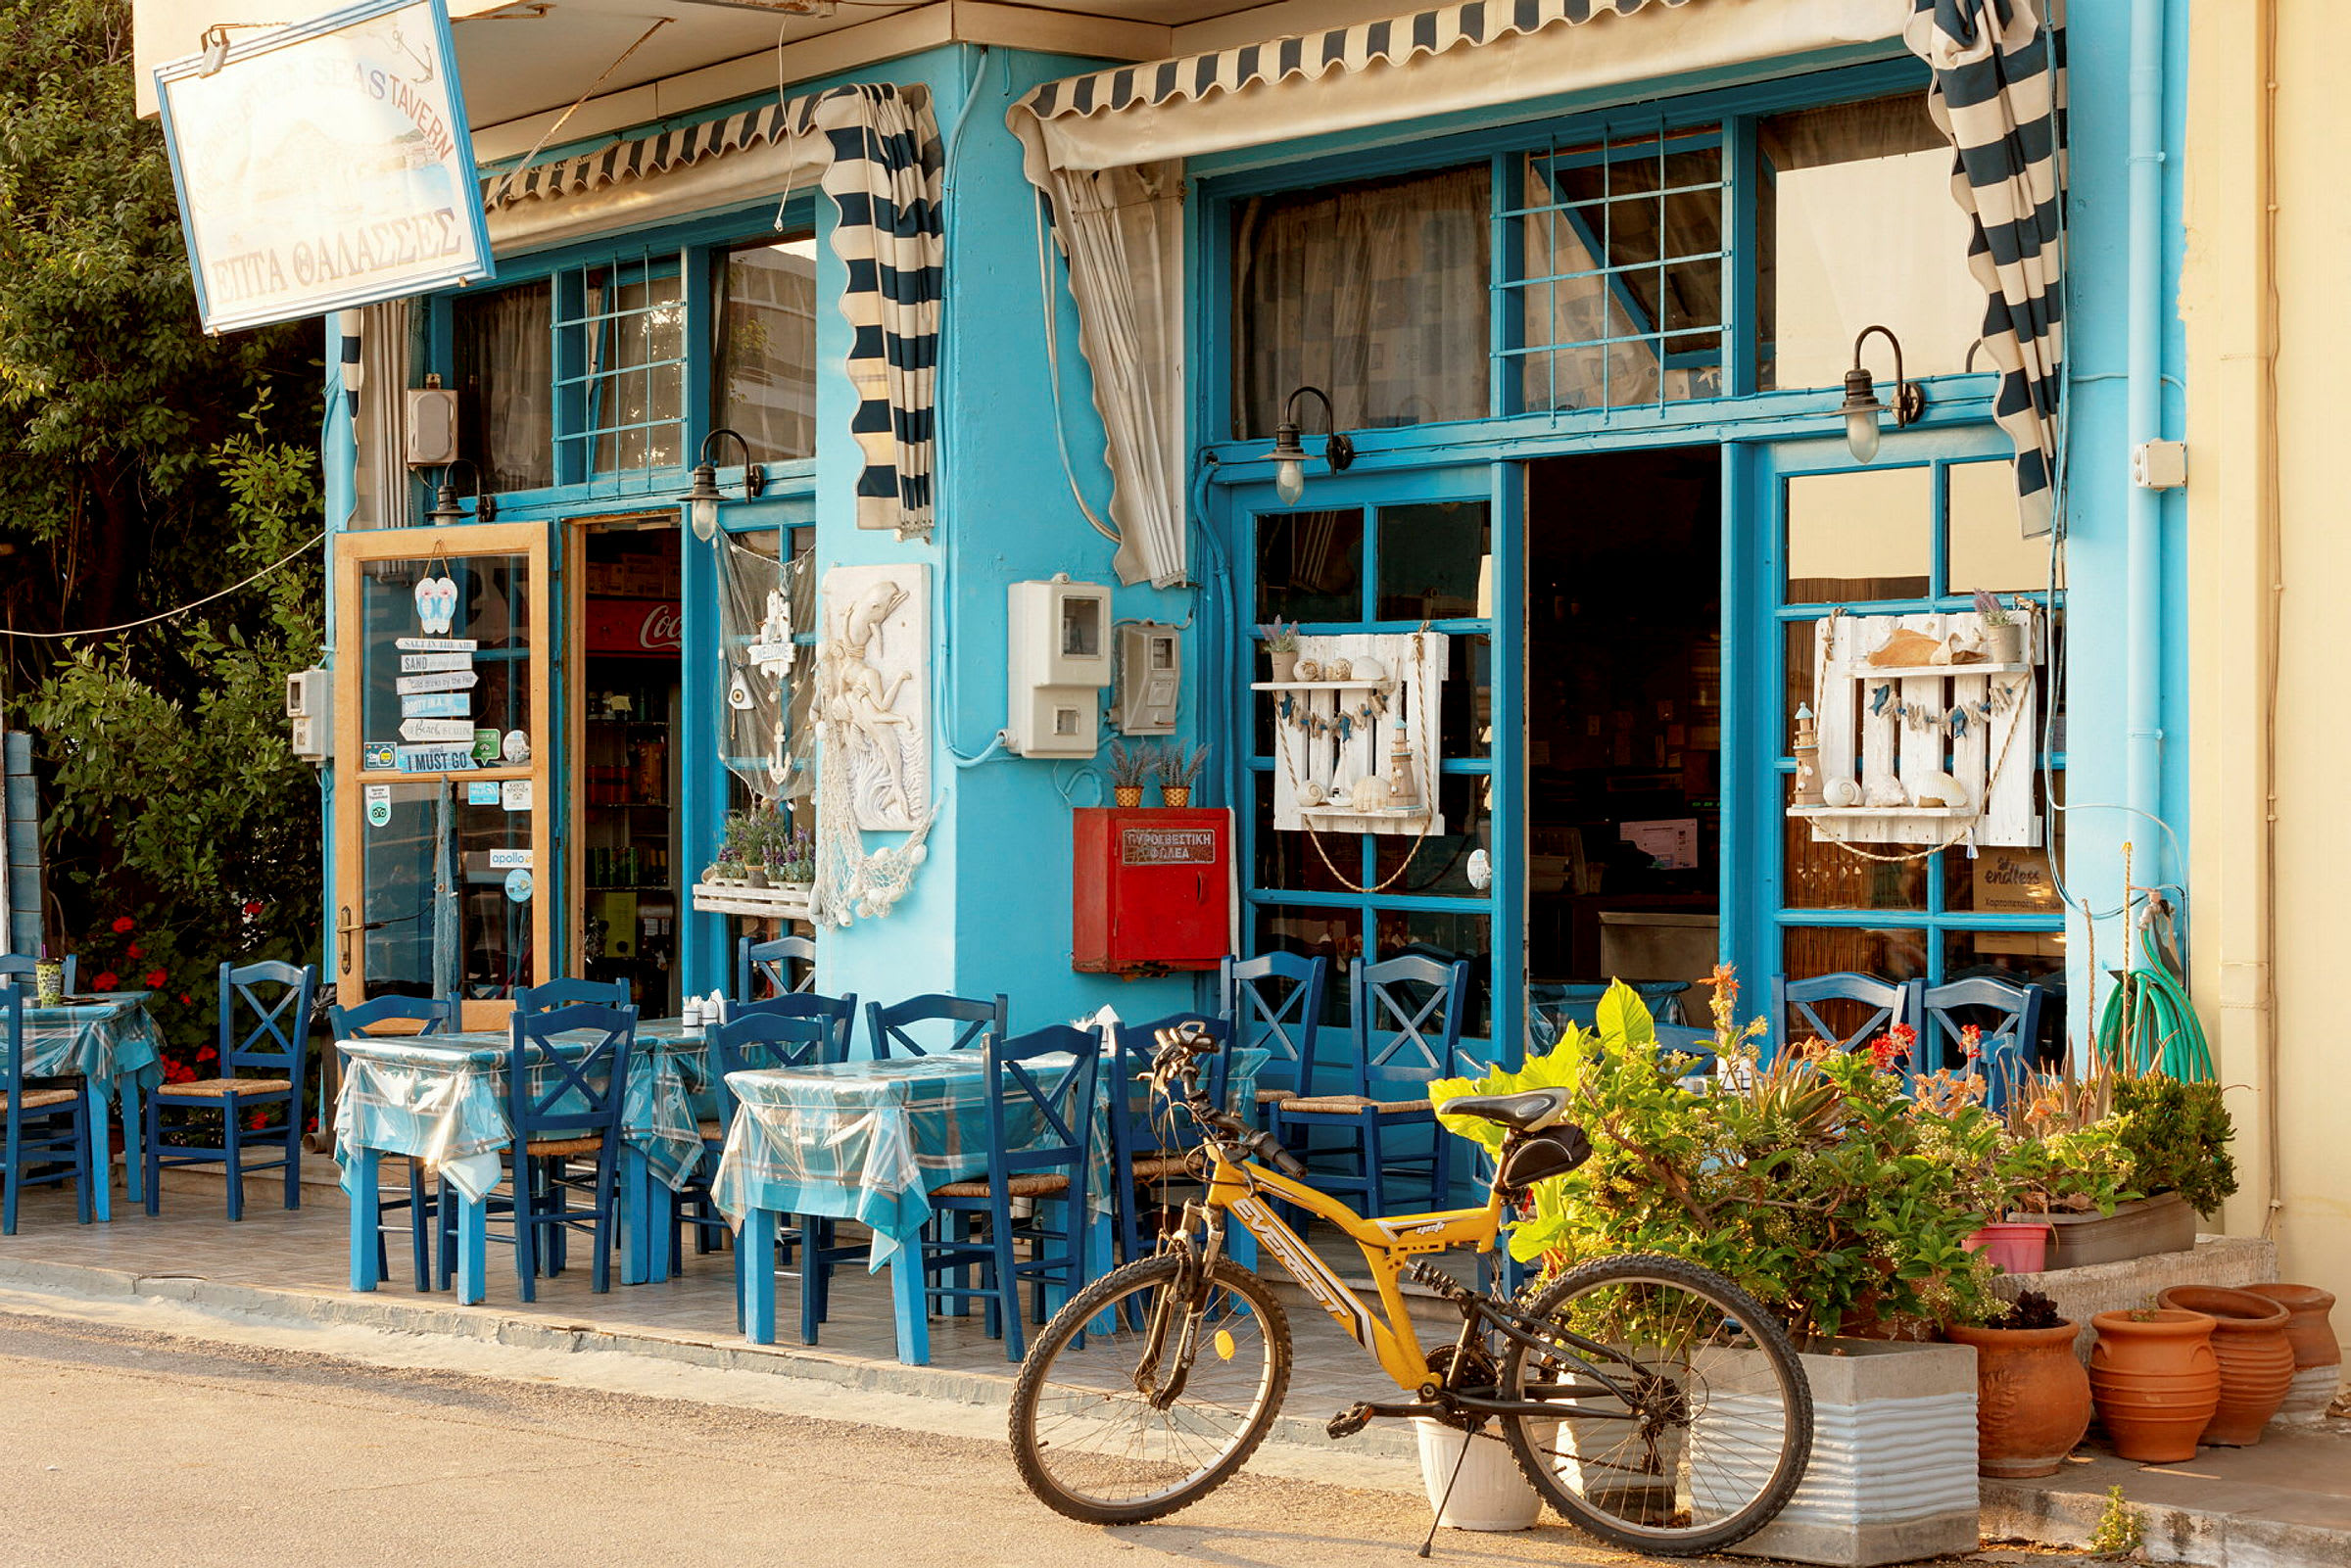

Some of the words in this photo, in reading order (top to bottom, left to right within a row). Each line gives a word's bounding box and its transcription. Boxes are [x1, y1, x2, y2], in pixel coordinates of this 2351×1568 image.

[389, 72, 456, 161] TAVERN
[211, 248, 289, 304] ΕΠΤΑ
[292, 206, 462, 288] ΘΑΛΑΣΣΕΣ
[405, 656, 427, 670] SAND
[415, 720, 441, 736] Beach
[407, 754, 412, 771] I
[414, 753, 448, 771] MUST
[452, 752, 467, 769] GO
[492, 852, 524, 865] apollo
[1985, 863, 2040, 884] endless
[1232, 1198, 1348, 1316] EVEREST
